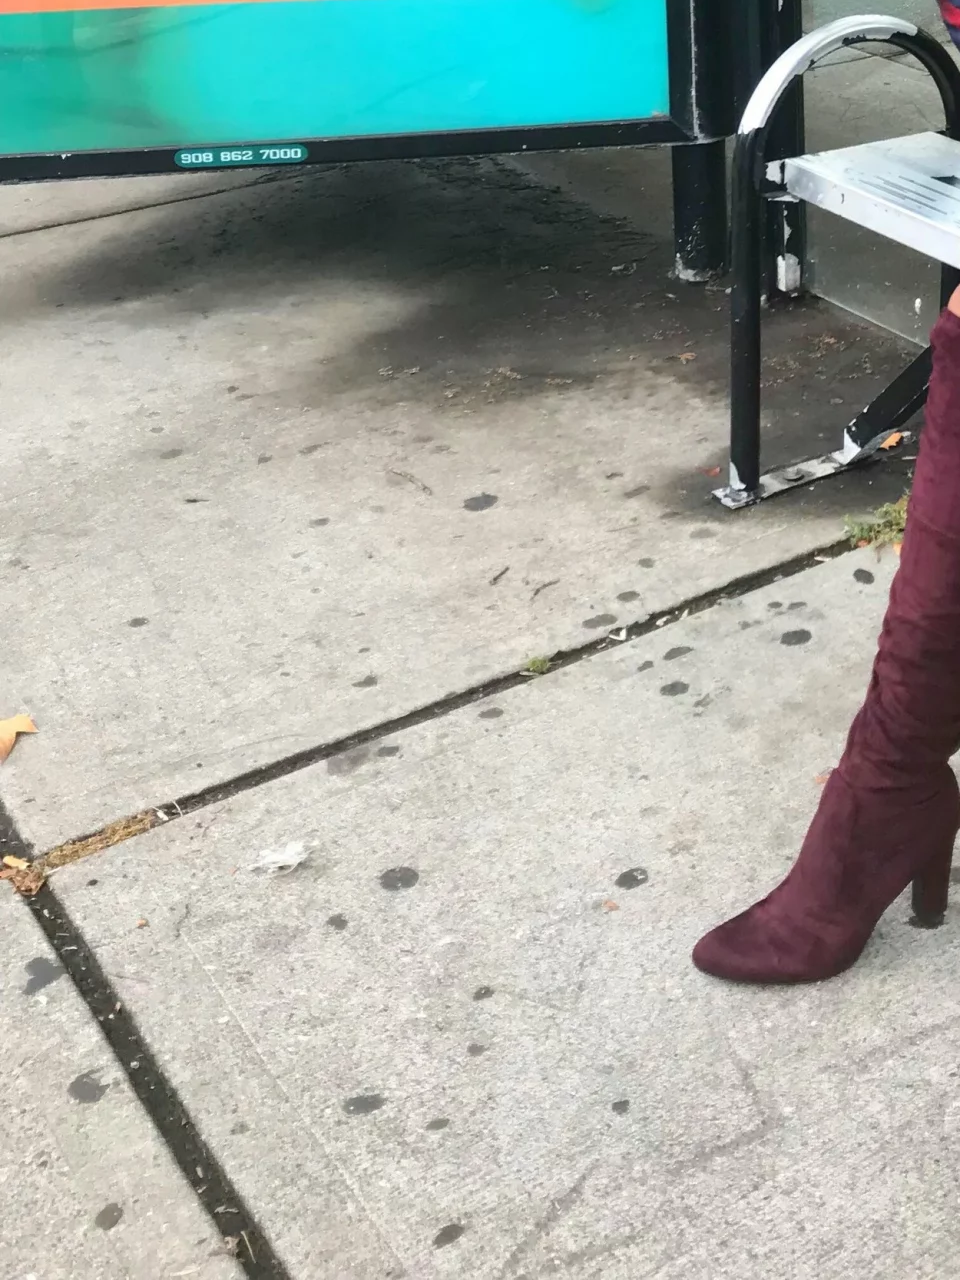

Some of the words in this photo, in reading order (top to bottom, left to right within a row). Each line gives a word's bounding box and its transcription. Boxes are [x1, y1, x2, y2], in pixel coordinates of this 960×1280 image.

[181, 152, 213, 164] 908
[220, 150, 253, 162] 862
[259, 148, 302, 160] 7000
